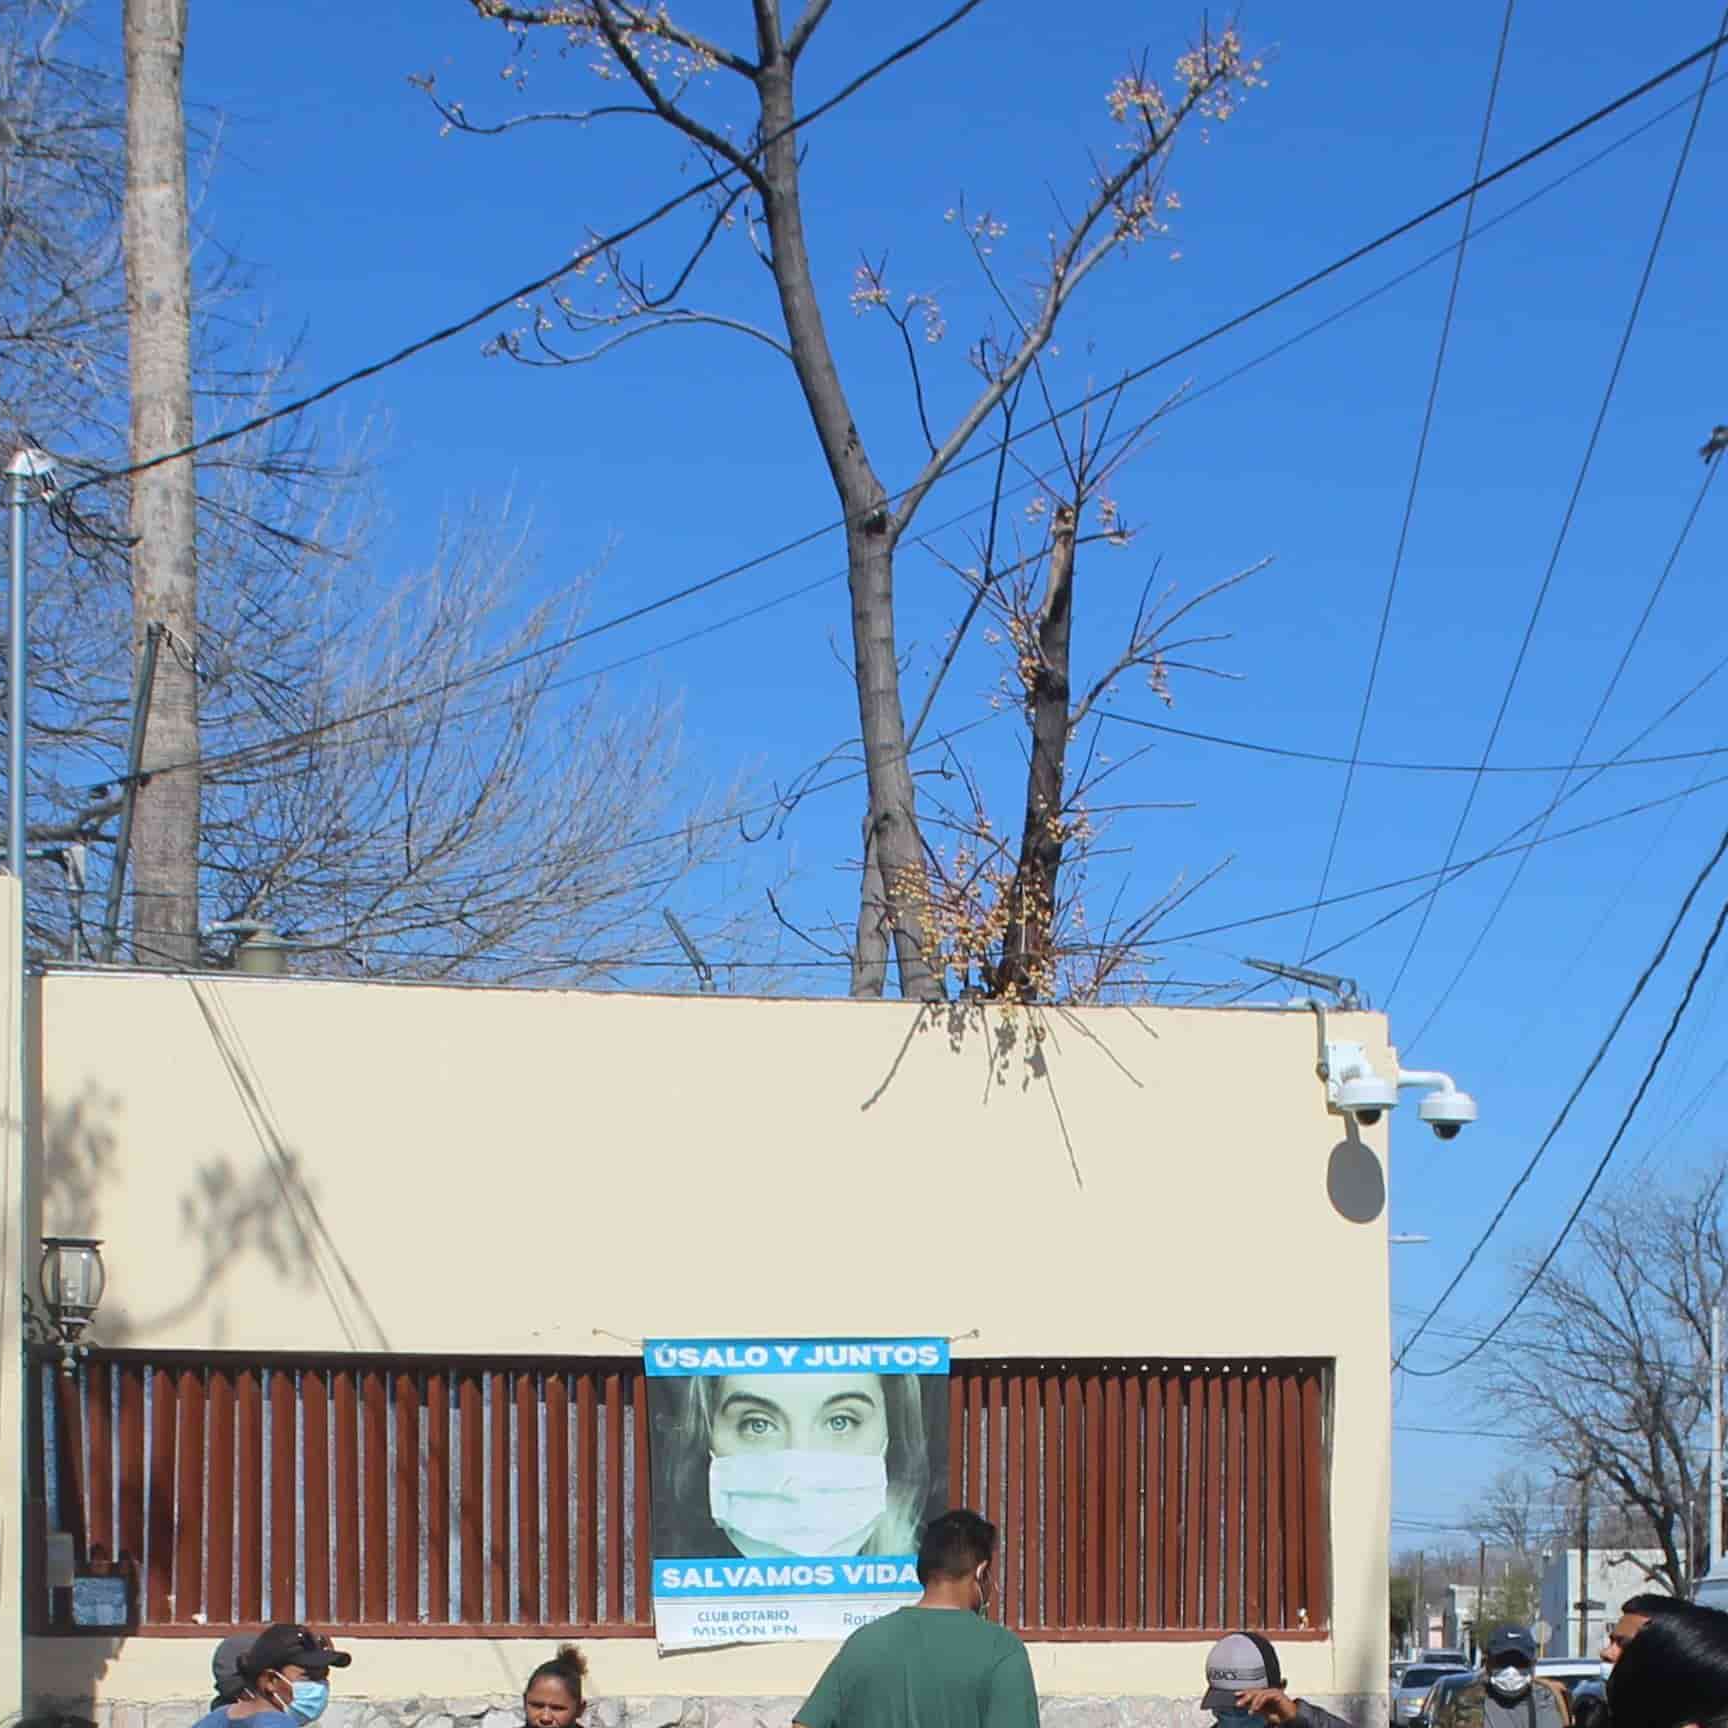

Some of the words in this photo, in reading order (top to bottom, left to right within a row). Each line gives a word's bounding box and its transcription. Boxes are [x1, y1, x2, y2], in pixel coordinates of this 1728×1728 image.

[654, 1343, 767, 1369] ÚSALO
[774, 1345, 800, 1367] Y
[805, 1345, 940, 1368] JUNTOS
[662, 1564, 835, 1589] SALVAMOS
[840, 1563, 921, 1585] VIDA
[697, 1610, 729, 1623] CLUB
[732, 1609, 790, 1622] ROTARIO
[692, 1624, 767, 1637] MISIÓN
